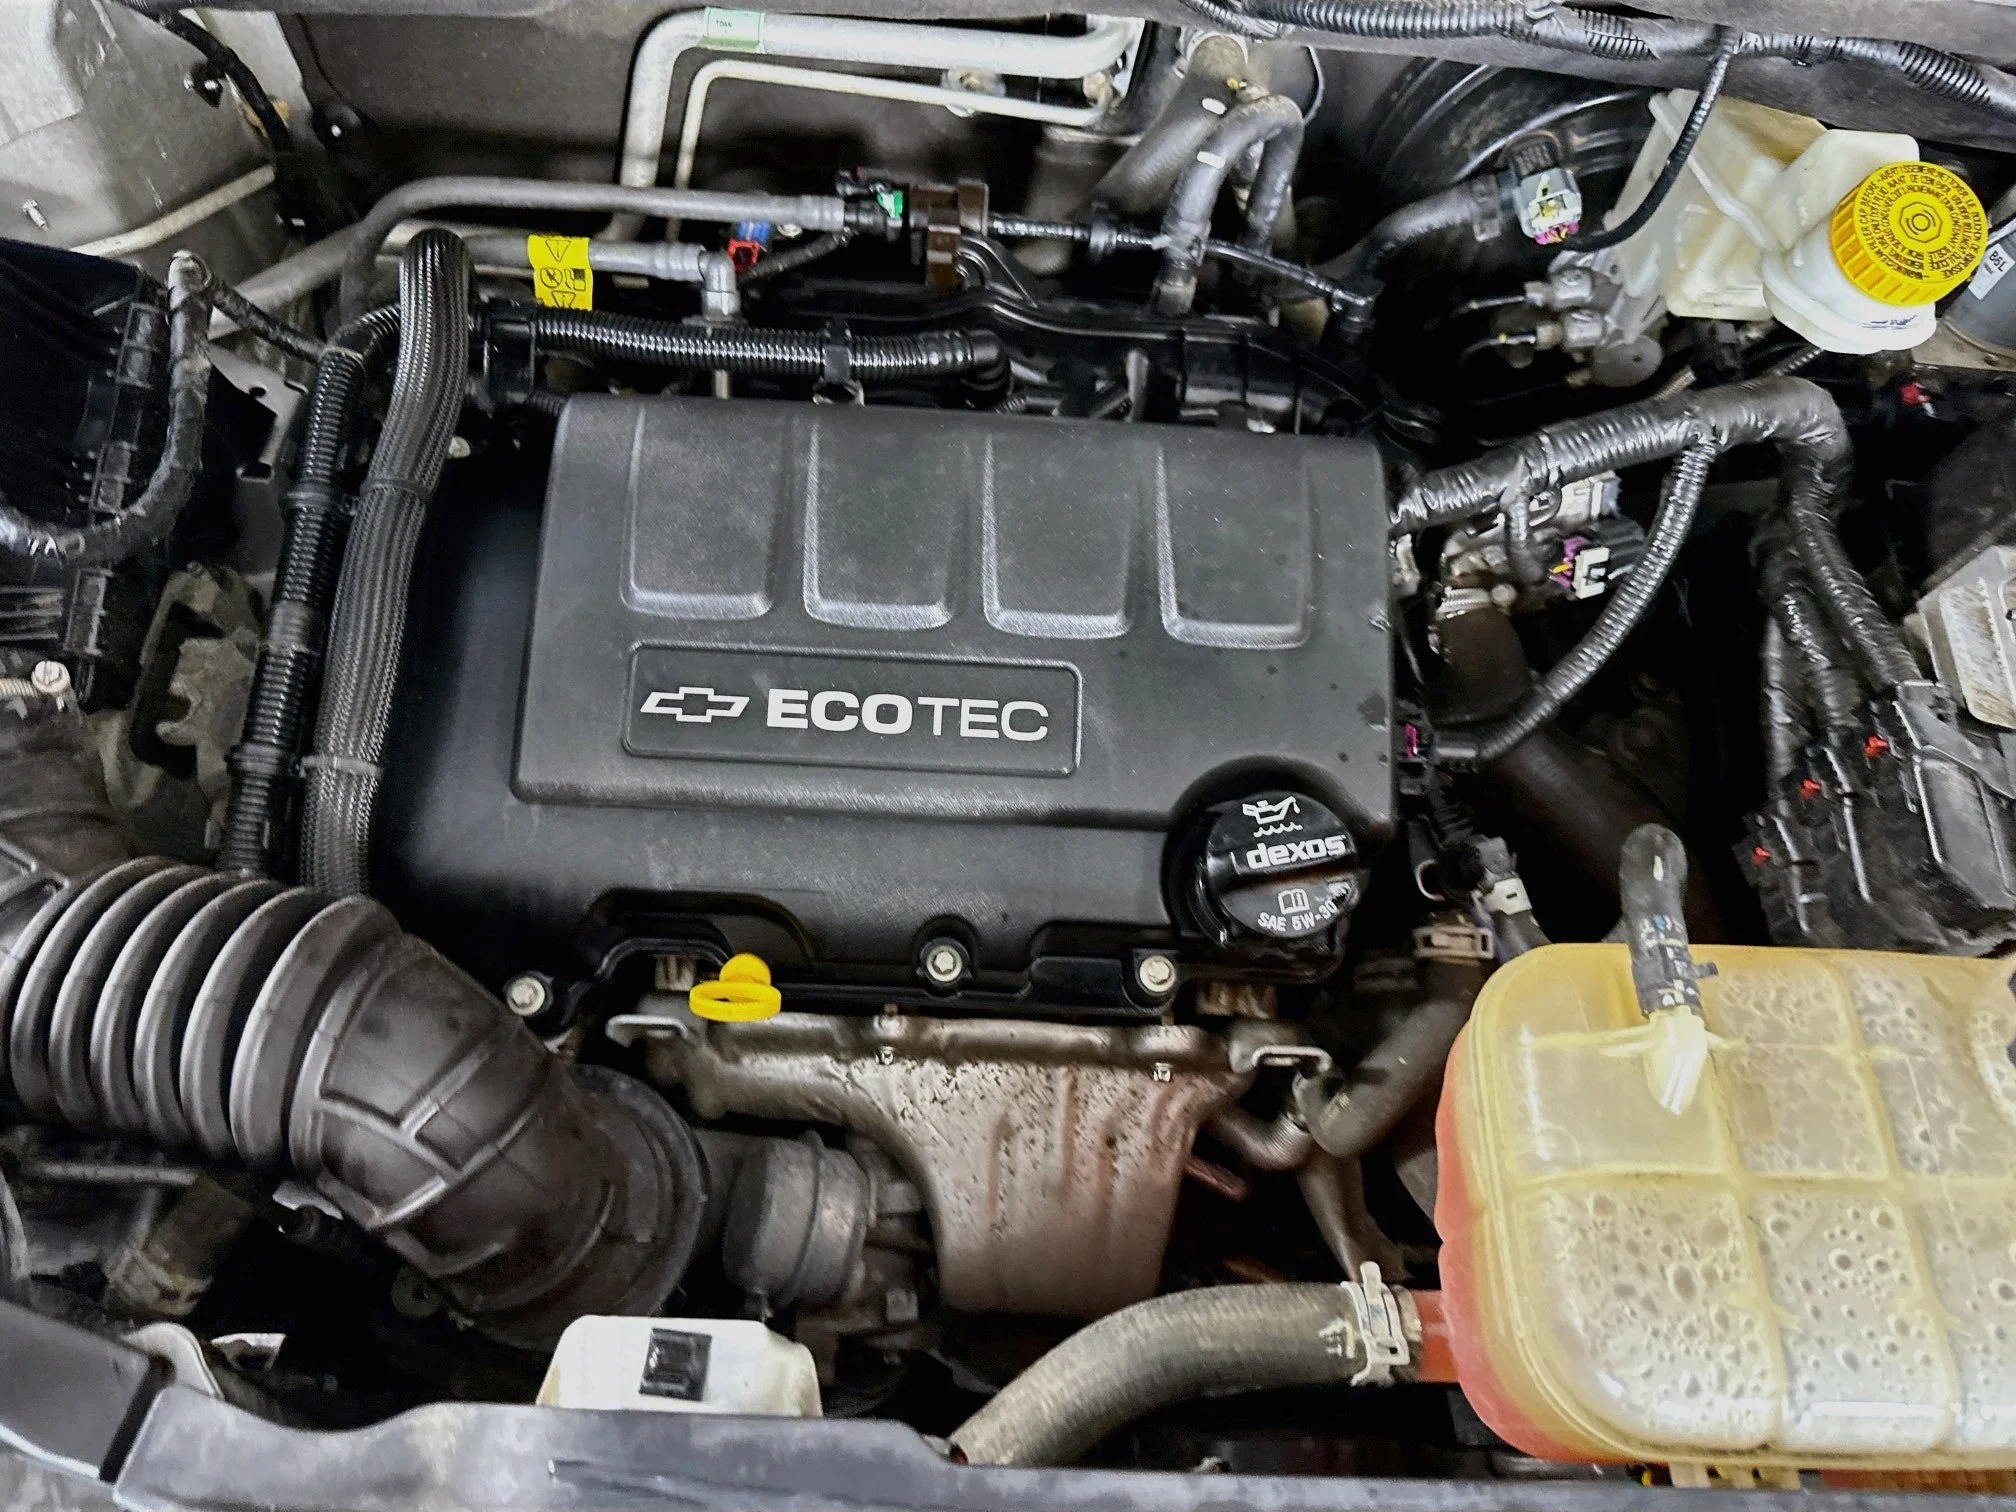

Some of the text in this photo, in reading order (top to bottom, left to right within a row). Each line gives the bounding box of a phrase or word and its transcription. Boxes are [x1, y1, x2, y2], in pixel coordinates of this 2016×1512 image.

[1861, 182, 1878, 206] BEFORE
[766, 688, 1049, 741] ECOTEC
[1246, 835, 1346, 869] dexos
[1257, 899, 1338, 932] SAE 5W-30
